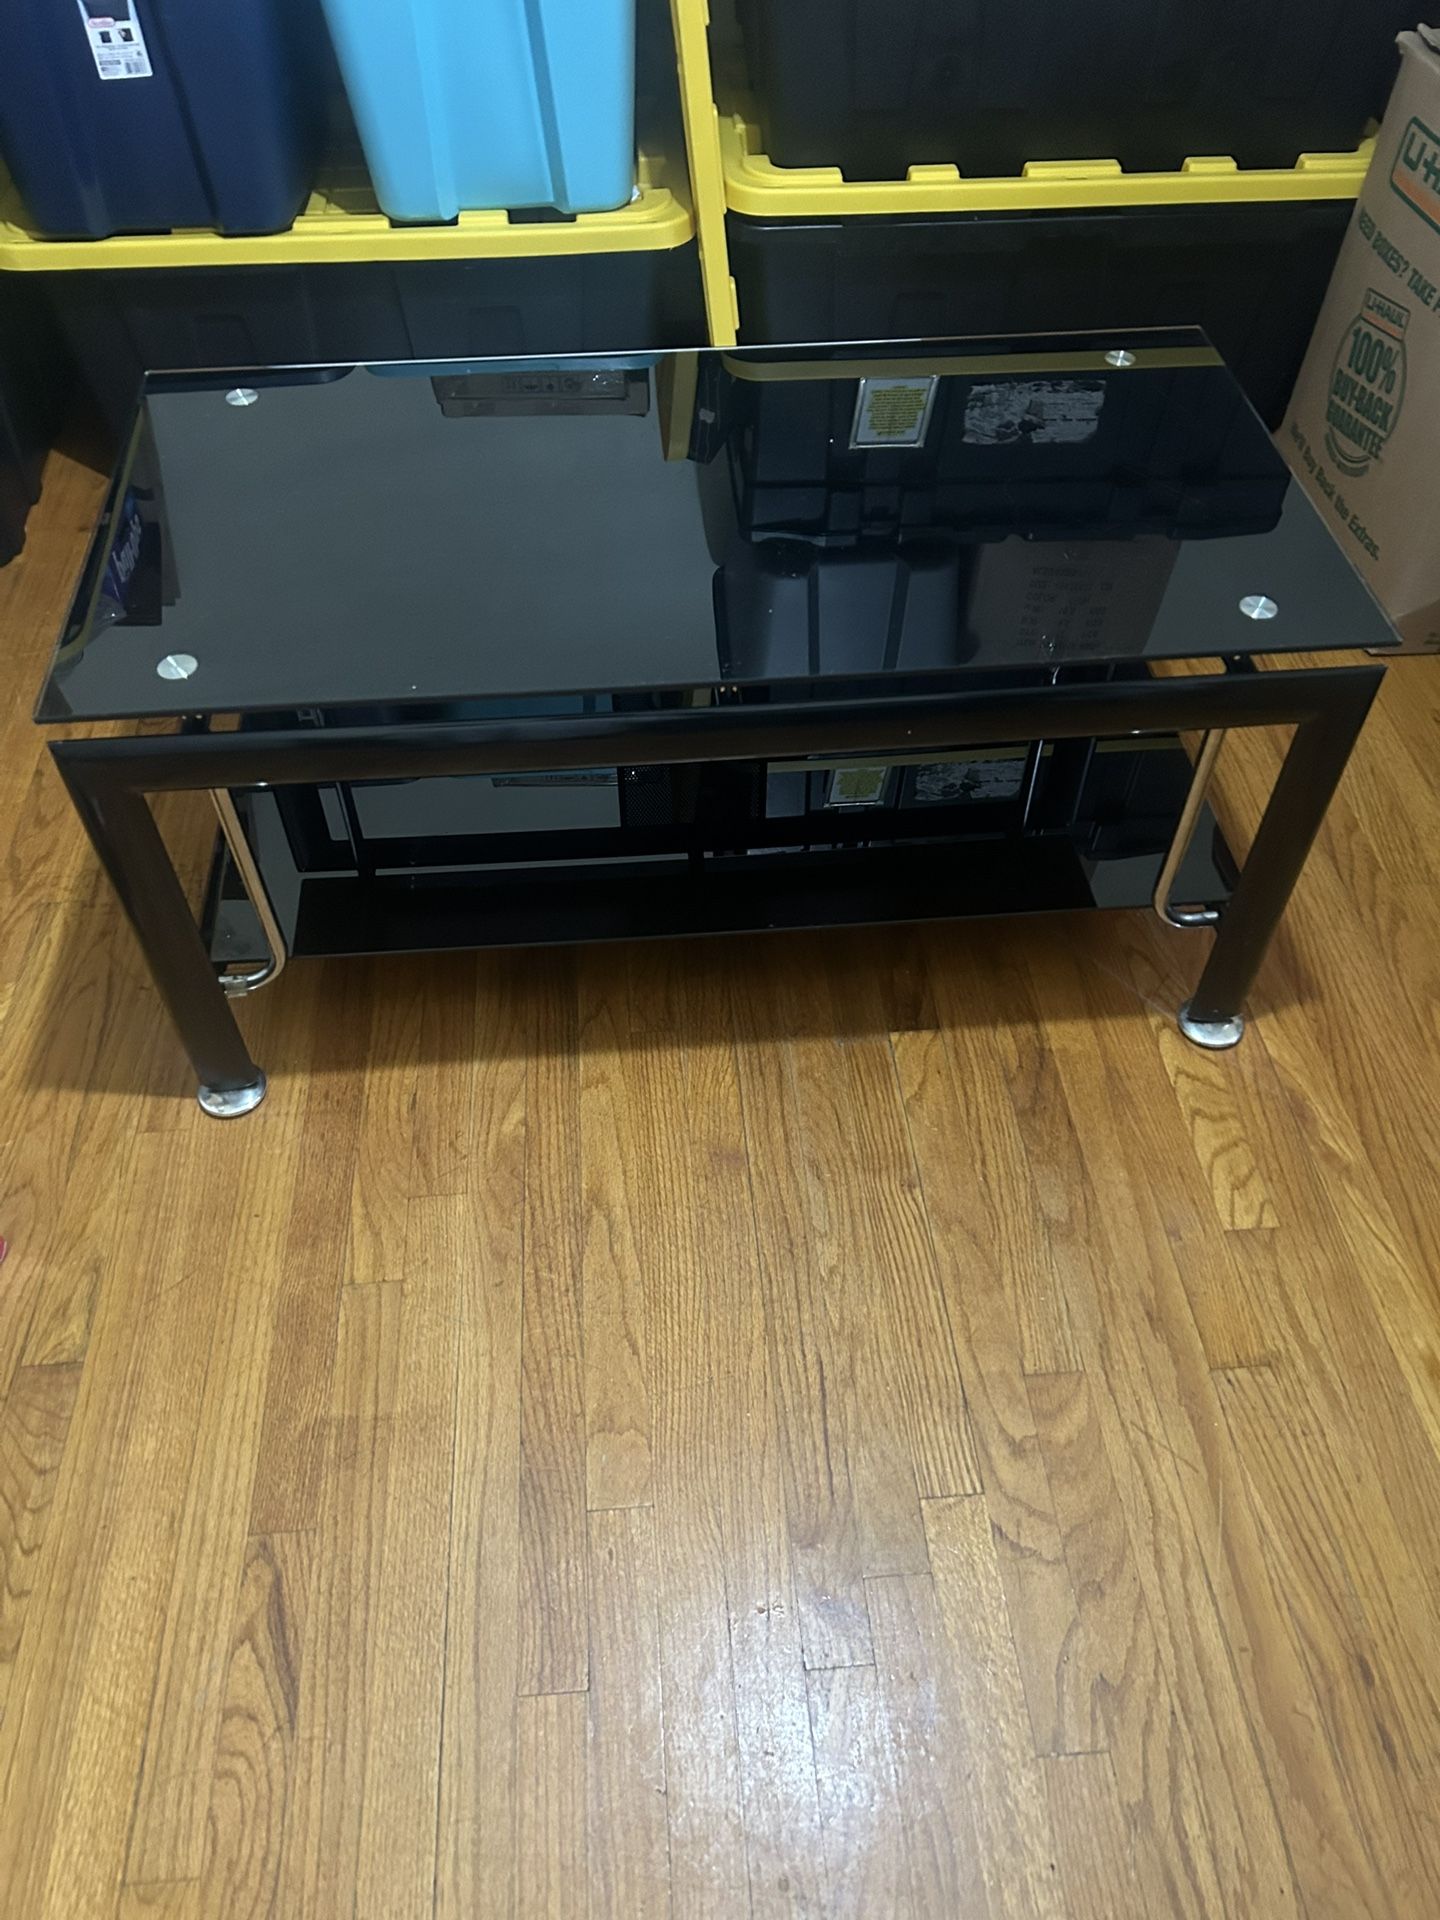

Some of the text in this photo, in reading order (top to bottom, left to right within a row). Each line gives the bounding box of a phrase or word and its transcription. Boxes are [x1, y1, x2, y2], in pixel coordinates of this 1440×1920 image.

[1402, 131, 1440, 196] U-H
[1366, 295, 1404, 329] U-HAUL
[1407, 267, 1437, 307] TAKE
[1348, 326, 1399, 394] 100%
[1326, 399, 1386, 460] GUARANTEE
[1333, 367, 1394, 433] BUY-BACK
